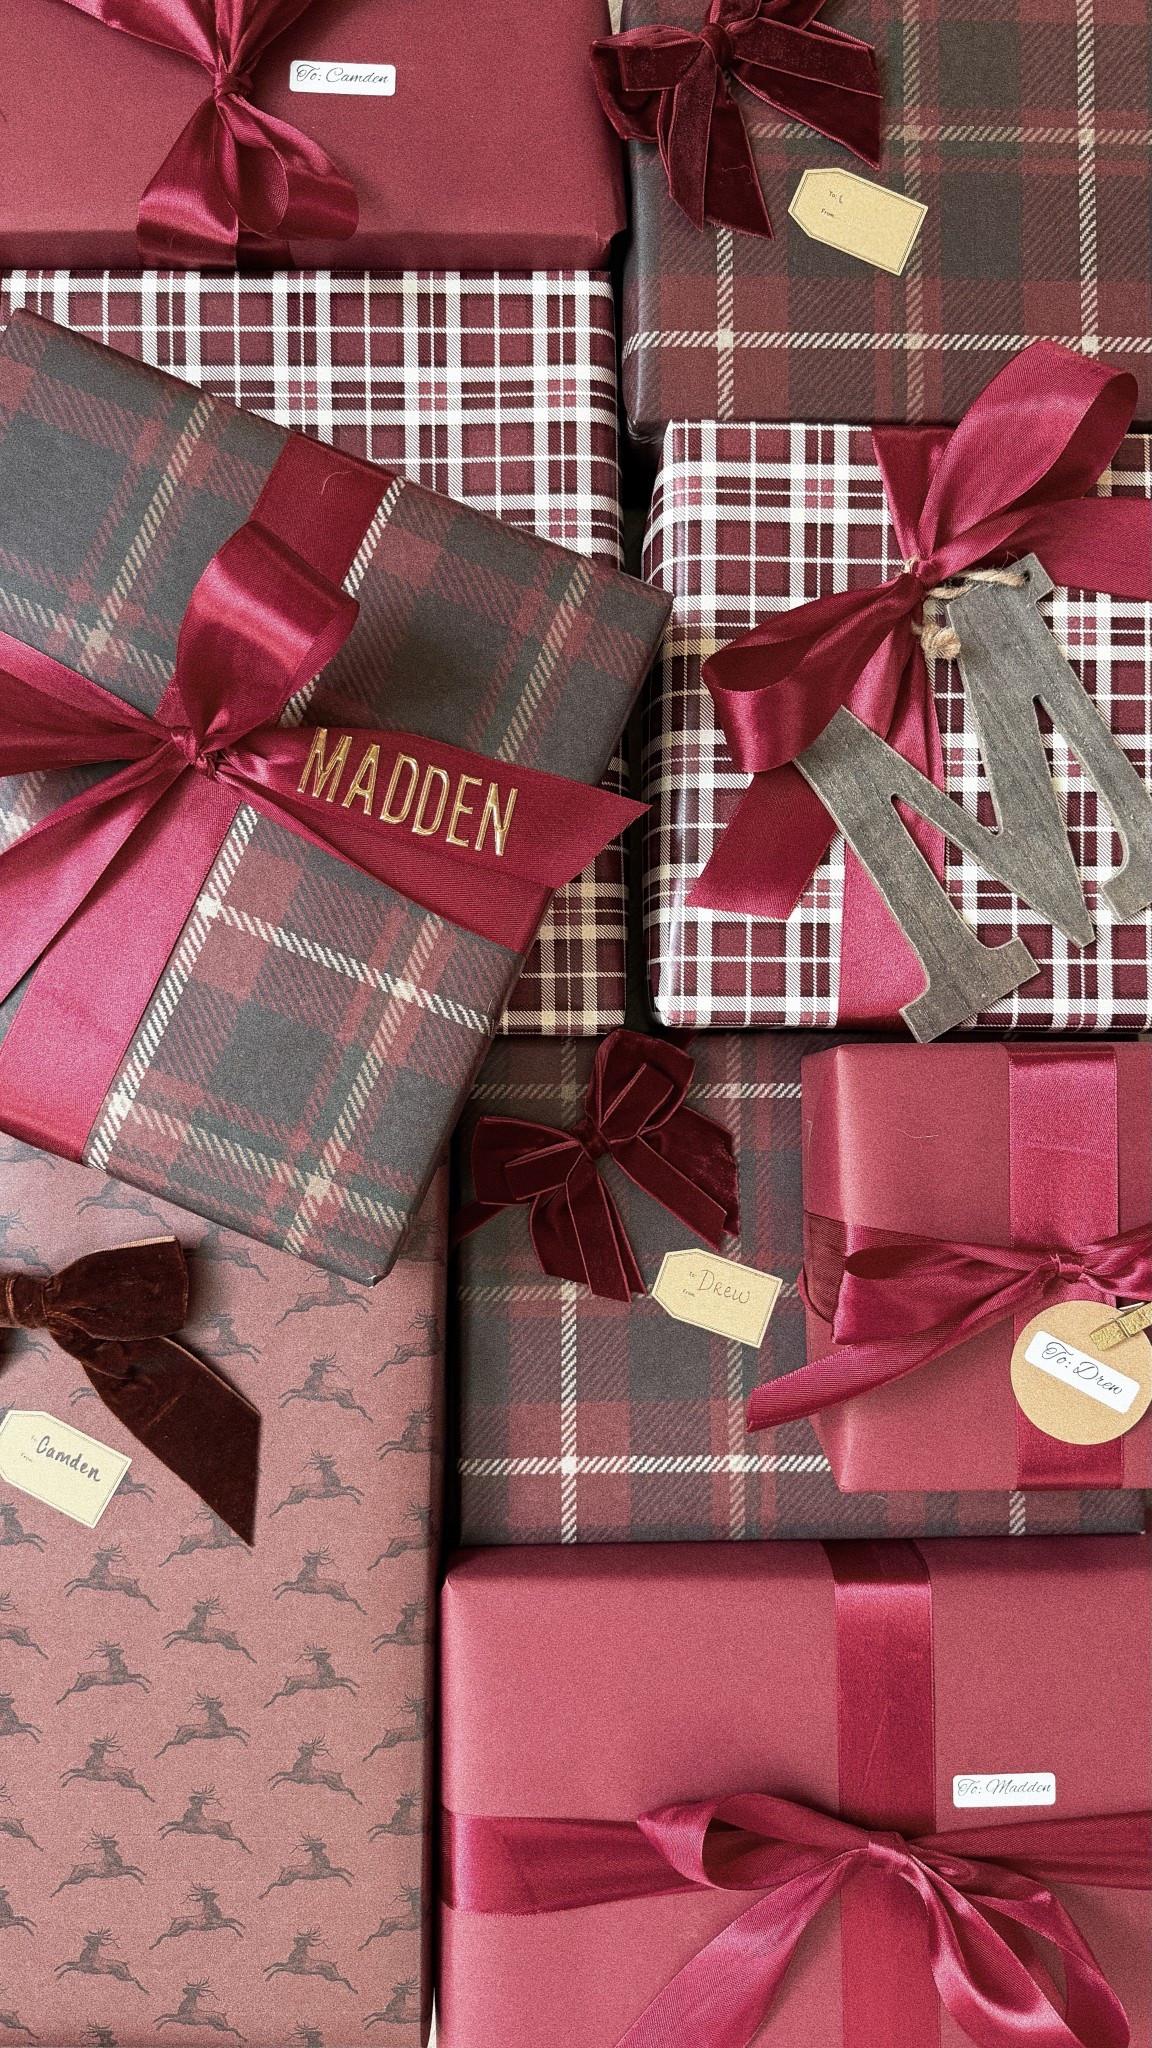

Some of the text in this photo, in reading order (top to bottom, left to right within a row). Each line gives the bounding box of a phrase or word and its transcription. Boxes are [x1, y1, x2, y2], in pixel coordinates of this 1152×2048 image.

[296, 64, 388, 84] To: Camden
[296, 726, 518, 857] MADDEN
[795, 552, 1152, 1044] M
[1041, 1341, 1123, 1395] To: Drew
[36, 1435, 101, 1482] Camden
[957, 1778, 1052, 1797] To: Madden
